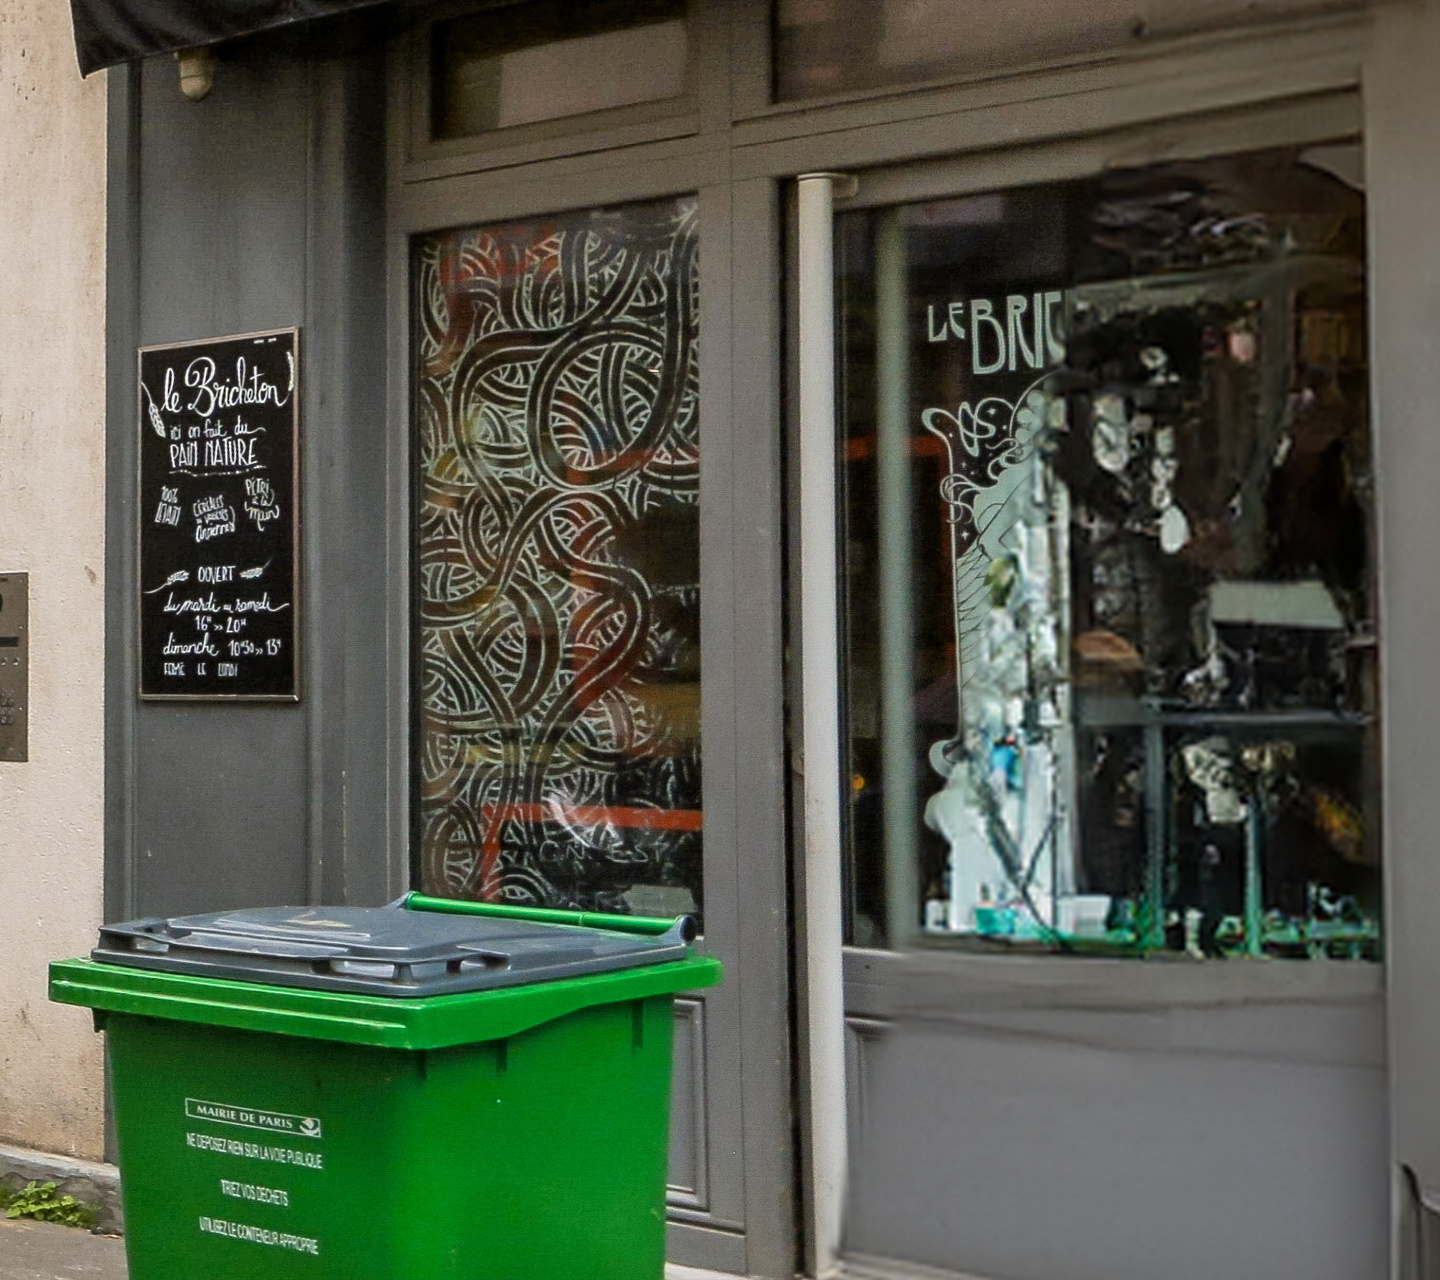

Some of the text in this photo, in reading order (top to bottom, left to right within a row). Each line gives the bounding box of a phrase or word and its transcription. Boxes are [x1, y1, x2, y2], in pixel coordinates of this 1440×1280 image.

[161, 356, 287, 417] le Bricheton
[205, 437, 258, 466] NATURE
[198, 565, 236, 584] OUVERT
[163, 632, 219, 656] dimanche
[196, 1105, 292, 1129] MAIRIE DE PARIS
